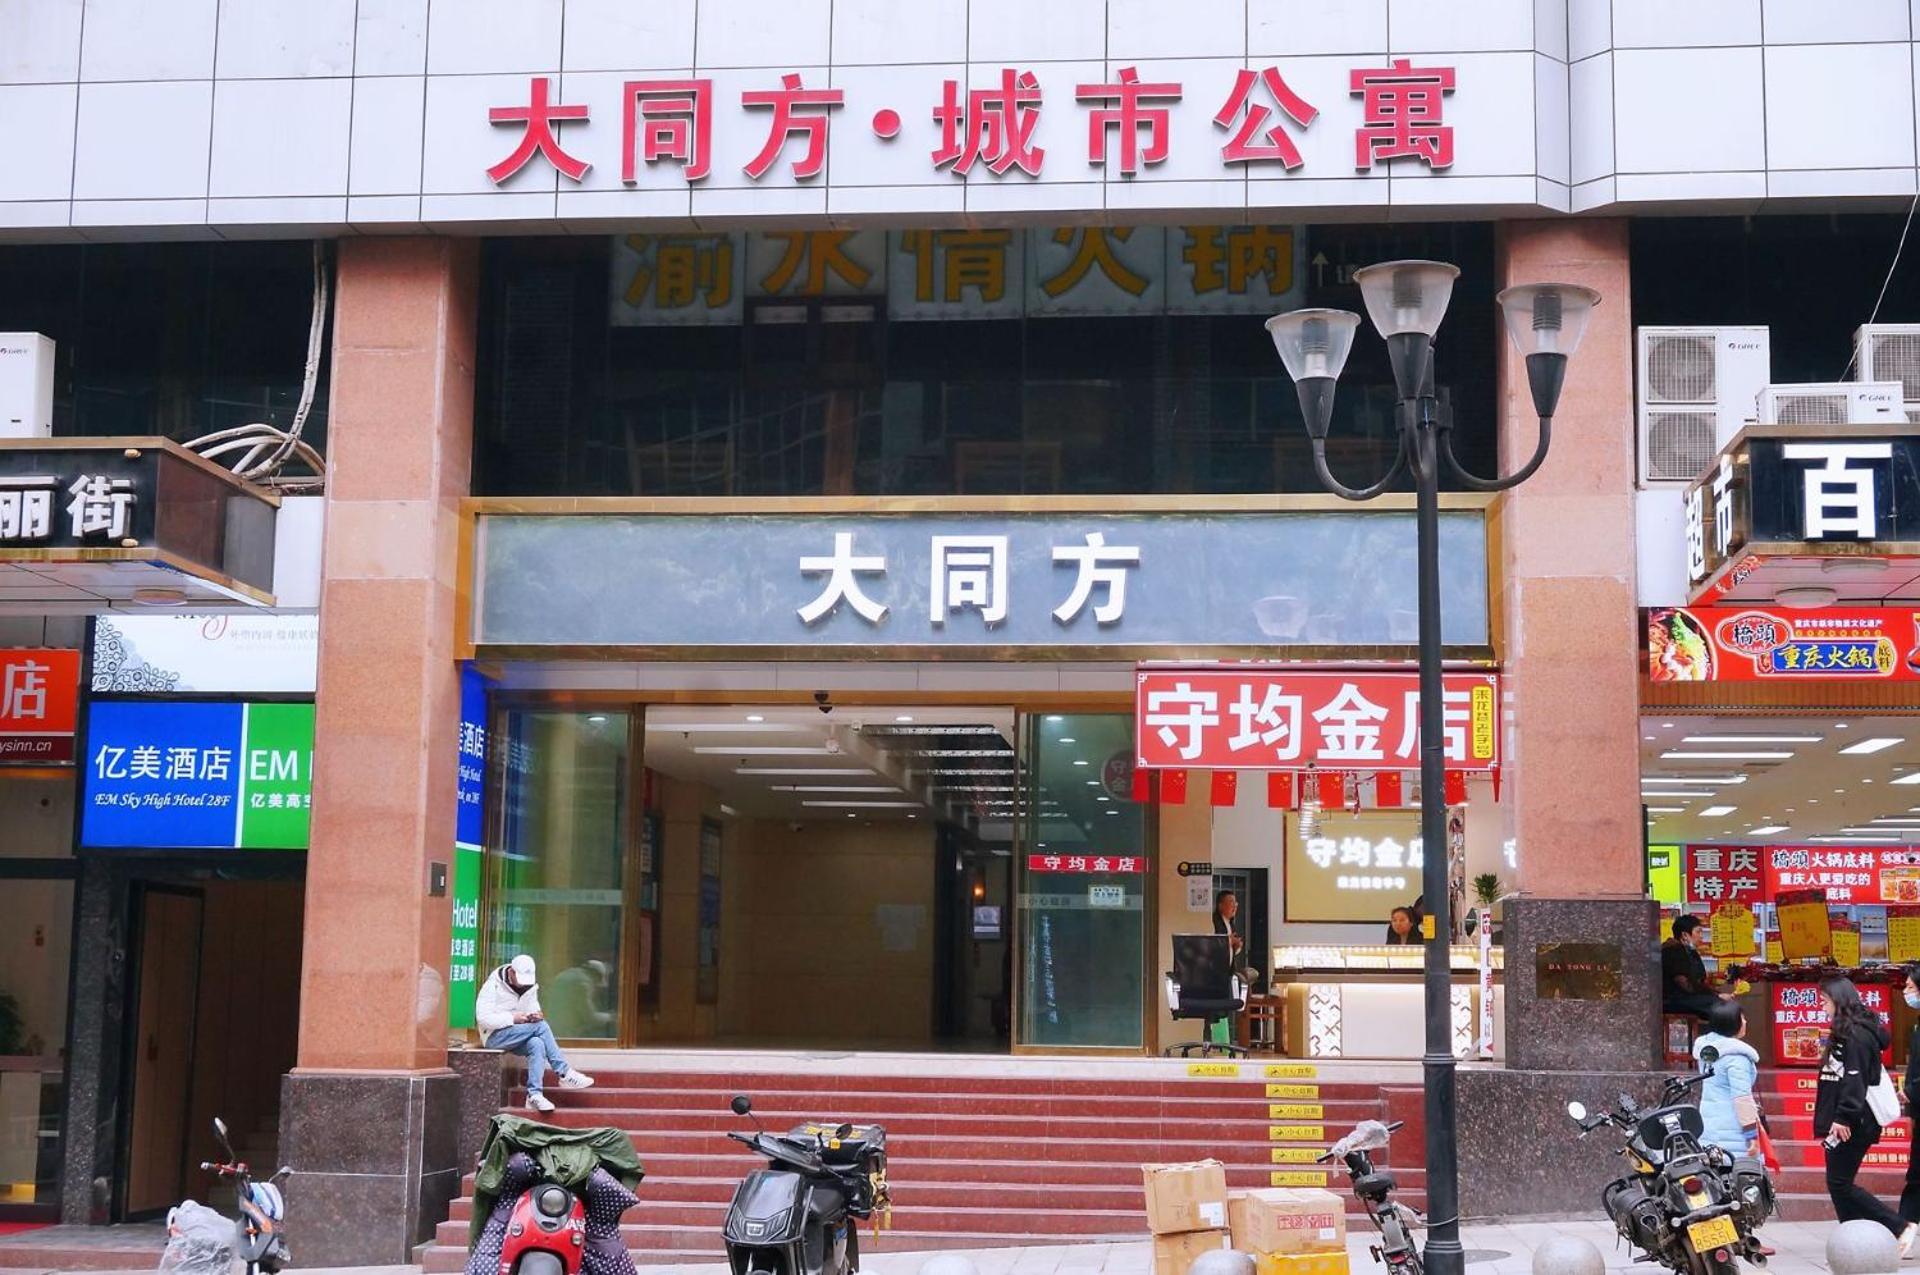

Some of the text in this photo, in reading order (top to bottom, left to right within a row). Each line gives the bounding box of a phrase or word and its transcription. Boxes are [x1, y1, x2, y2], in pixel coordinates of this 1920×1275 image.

[485, 58, 1456, 185] 大同方·城市公寓
[1783, 443, 1893, 539] 百
[797, 532, 1140, 625] 大同方
[0, 660, 50, 719] 店
[1145, 682, 1471, 760] 守均金店
[95, 745, 232, 780] 亿美酒店
[250, 750, 298, 781] EM
[95, 793, 118, 806] EM
[119, 793, 142, 809] Sky
[142, 793, 171, 809] High
[172, 793, 205, 807] Hotel
[1044, 857, 1135, 871] 守均金店
[1693, 849, 1758, 872] 重庆
[1693, 877, 1758, 899] 特产
[1780, 873, 1871, 886] 重庆人更爱吃的
[452, 899, 478, 928] Hotel
[1775, 1010, 1832, 1024] 重庆人更爱
